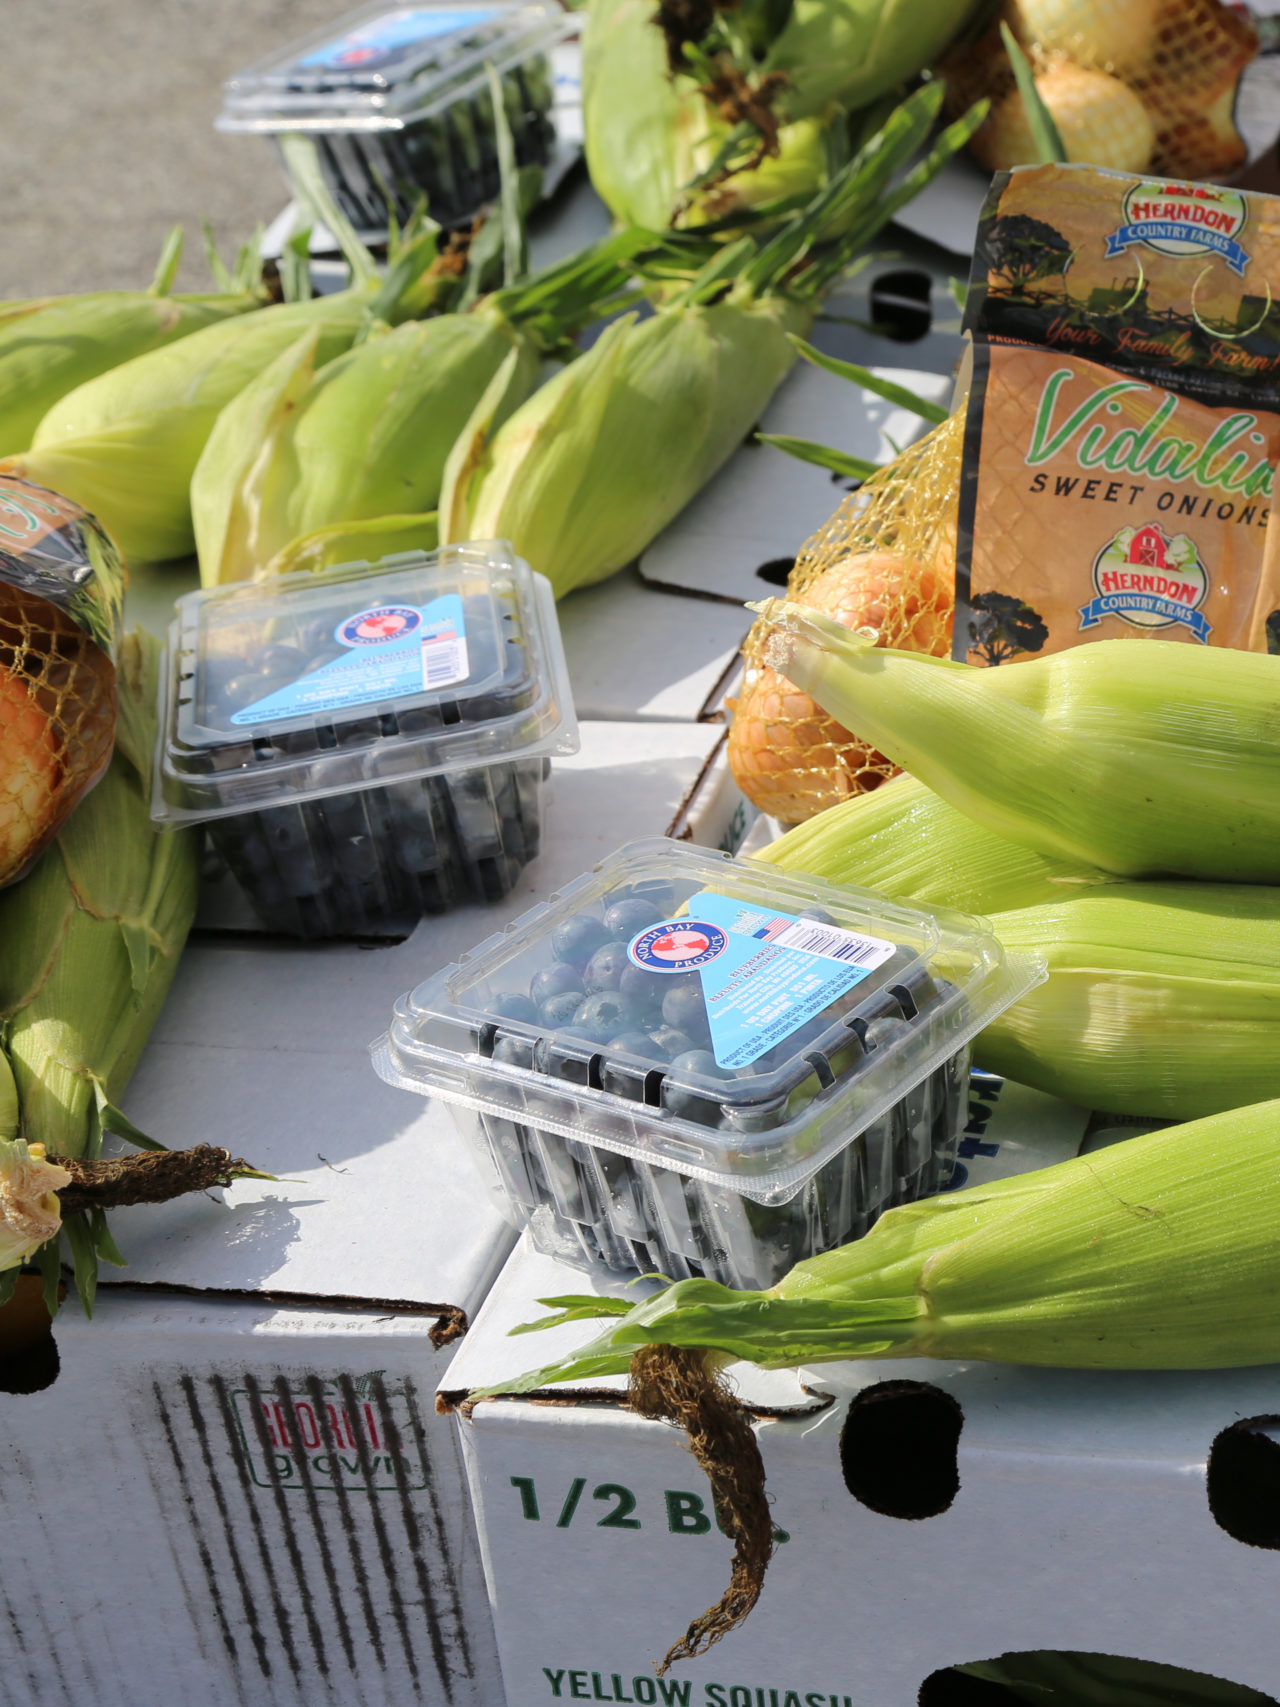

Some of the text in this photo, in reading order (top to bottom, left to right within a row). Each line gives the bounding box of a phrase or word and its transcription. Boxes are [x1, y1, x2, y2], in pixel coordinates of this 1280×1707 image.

[1130, 201, 1237, 235] HERNDON
[1127, 224, 1230, 251] COUNTRY FARMS
[1043, 316, 1101, 346] Your
[1112, 327, 1195, 367] Family
[1023, 369, 1276, 498] Vidalia
[1029, 473, 1272, 528] SWEET ONIONS
[1101, 570, 1199, 605] HERNDON
[1100, 596, 1195, 622] COUNTRY FARMS
[351, 627, 410, 644] PRODUCE
[637, 923, 695, 960] NORTH BAY
[673, 933, 723, 968] PRODUCE
[728, 943, 777, 978] BLUEBERRIES
[510, 1476, 642, 1529] 1/2
[542, 1667, 693, 1707] YELLOW
